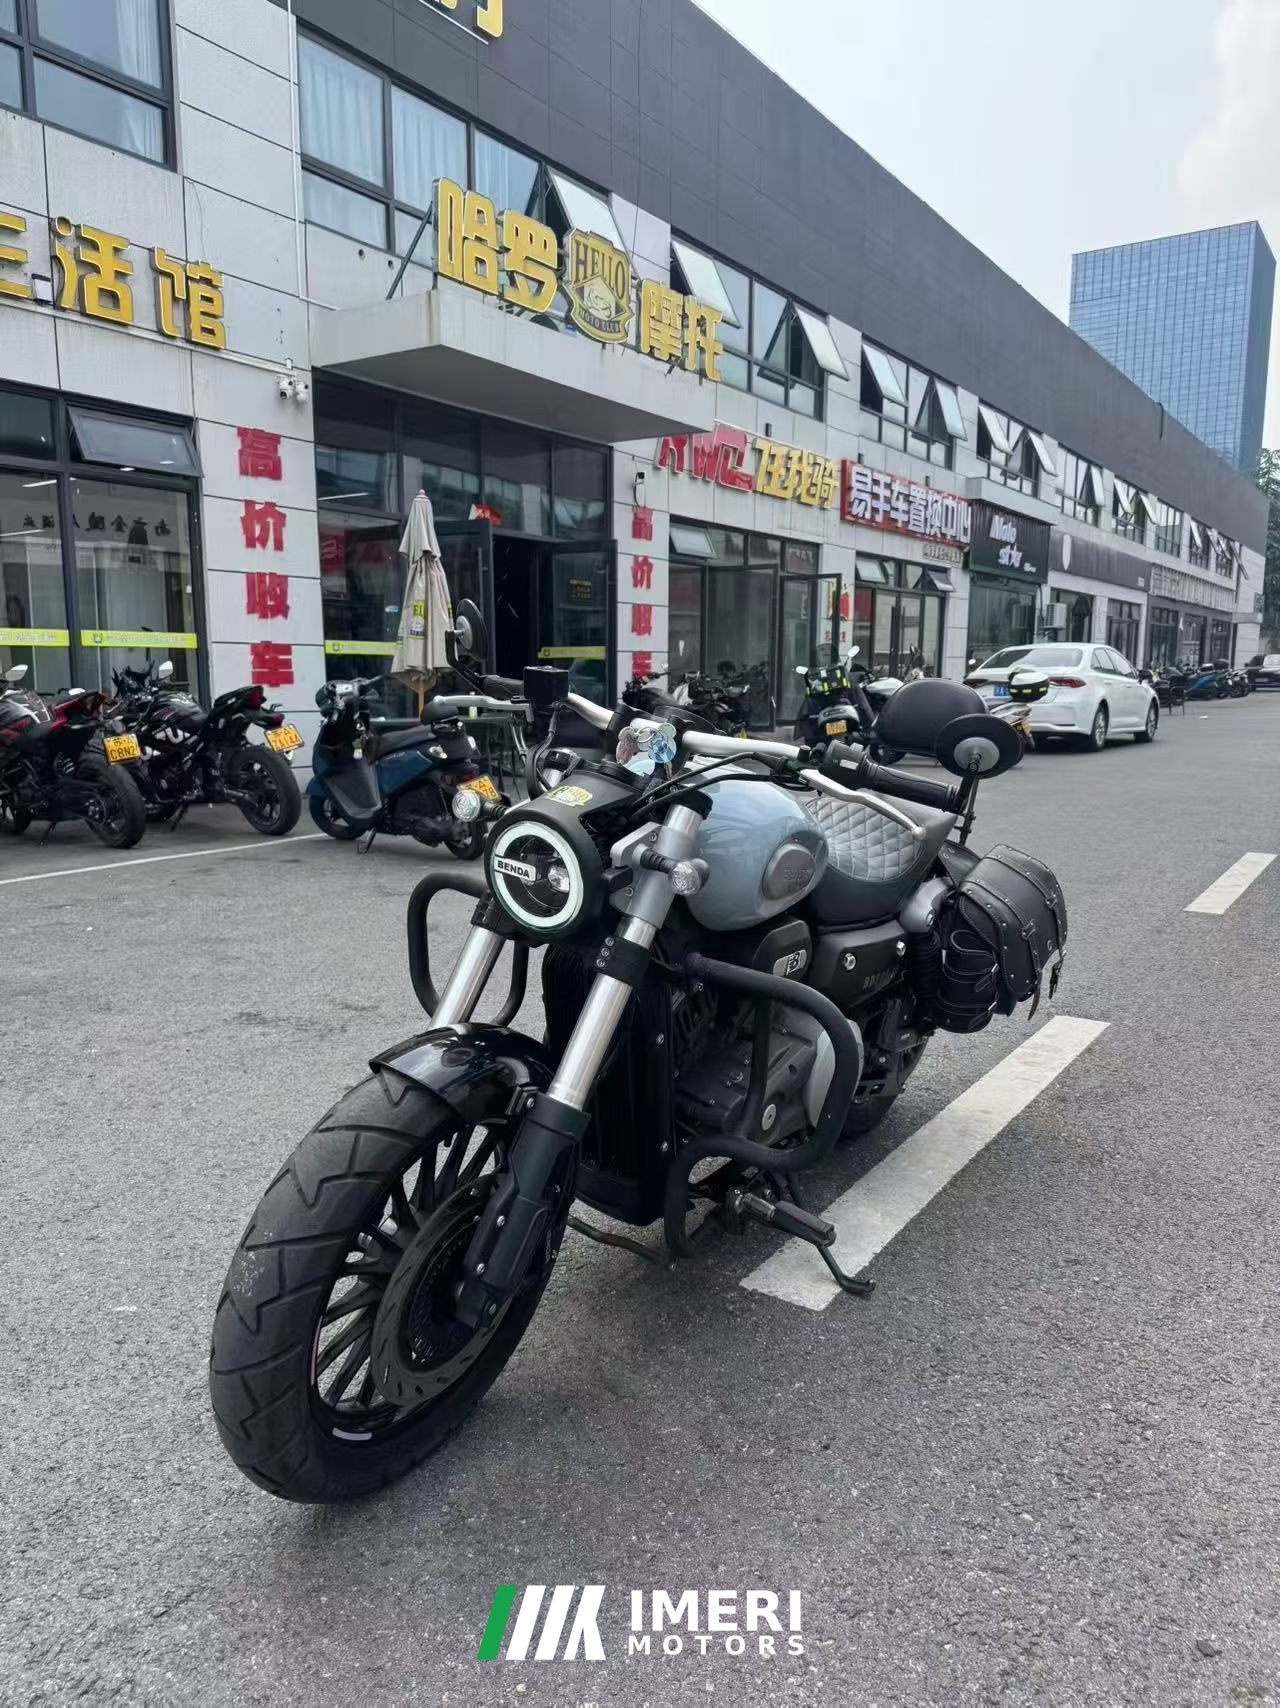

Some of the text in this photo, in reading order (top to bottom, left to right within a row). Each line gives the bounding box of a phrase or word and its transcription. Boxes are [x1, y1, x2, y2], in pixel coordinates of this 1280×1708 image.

[437, 178, 723, 382] 哈罗 摩托
[573, 239, 626, 301] HELLO
[236, 425, 295, 688] 高价收车
[497, 860, 530, 879] BENDA
